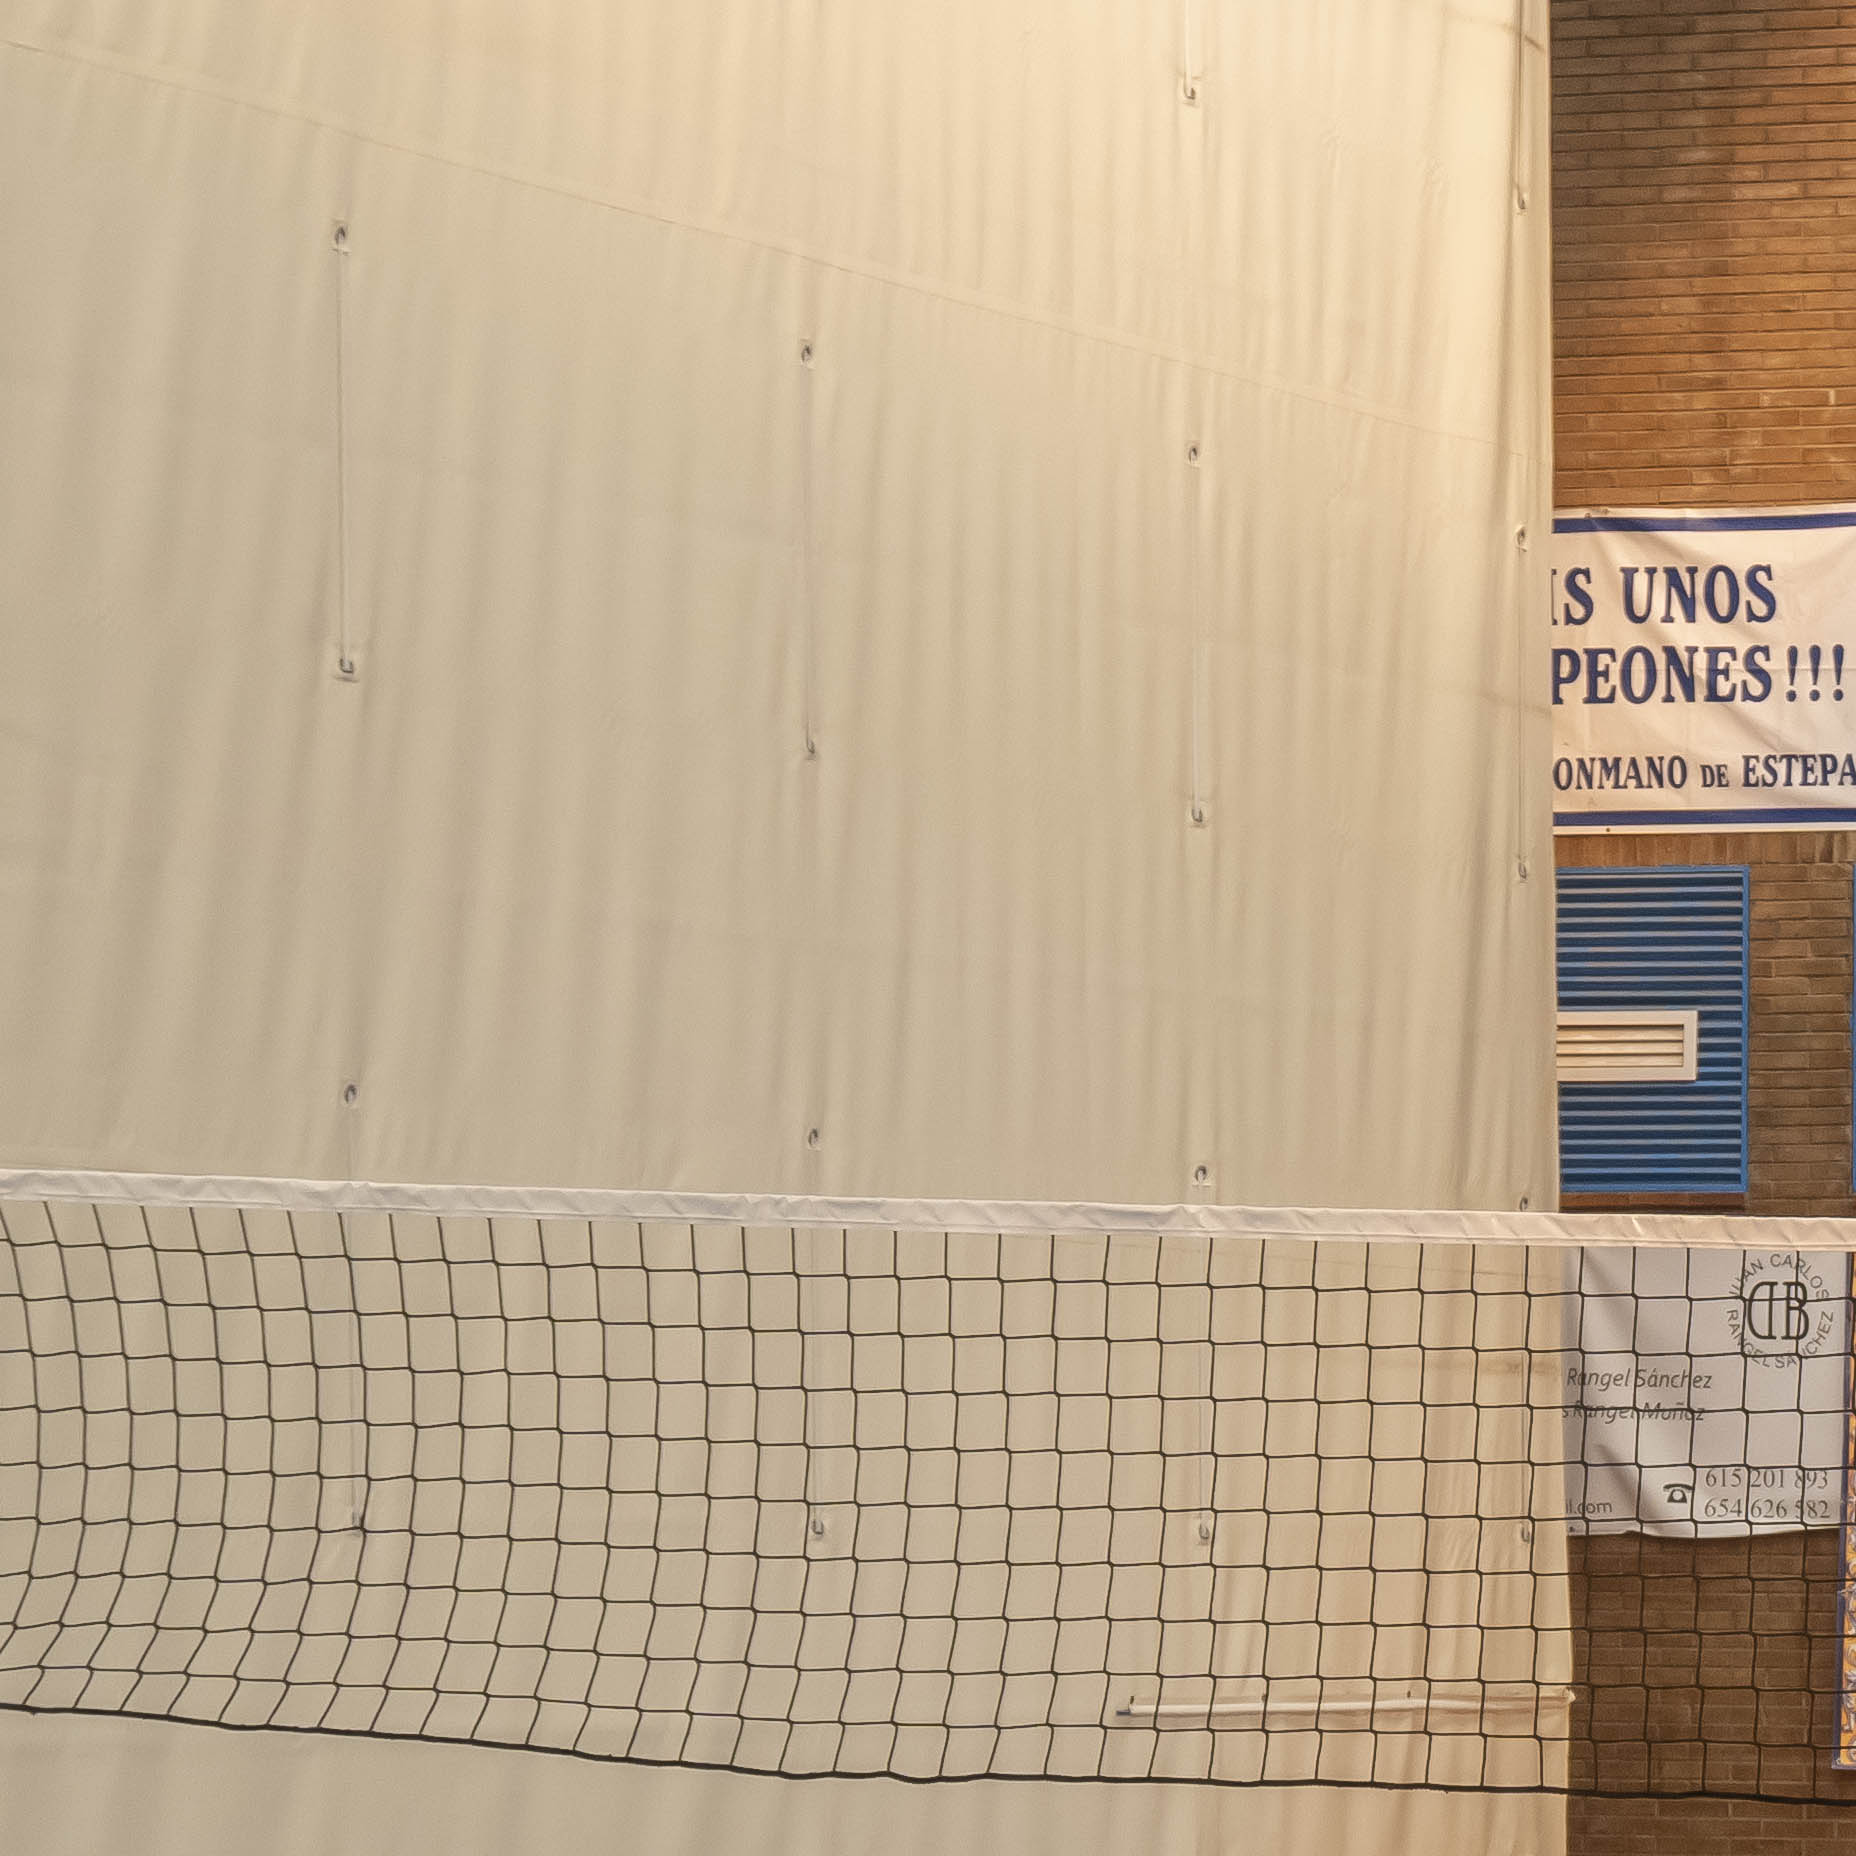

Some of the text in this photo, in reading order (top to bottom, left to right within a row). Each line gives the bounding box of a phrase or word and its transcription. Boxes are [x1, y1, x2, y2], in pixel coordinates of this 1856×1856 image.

[1620, 564, 1777, 624] UNOS
[1552, 644, 1845, 705] PEONES!!!
[1553, 756, 1687, 790] ONMANO
[1701, 765, 1729, 788] DE
[1705, 1471, 1742, 1488] 615
[1751, 1471, 1785, 1488] 201
[1704, 1499, 1742, 1518] 654
[1751, 1501, 1787, 1518] 626
